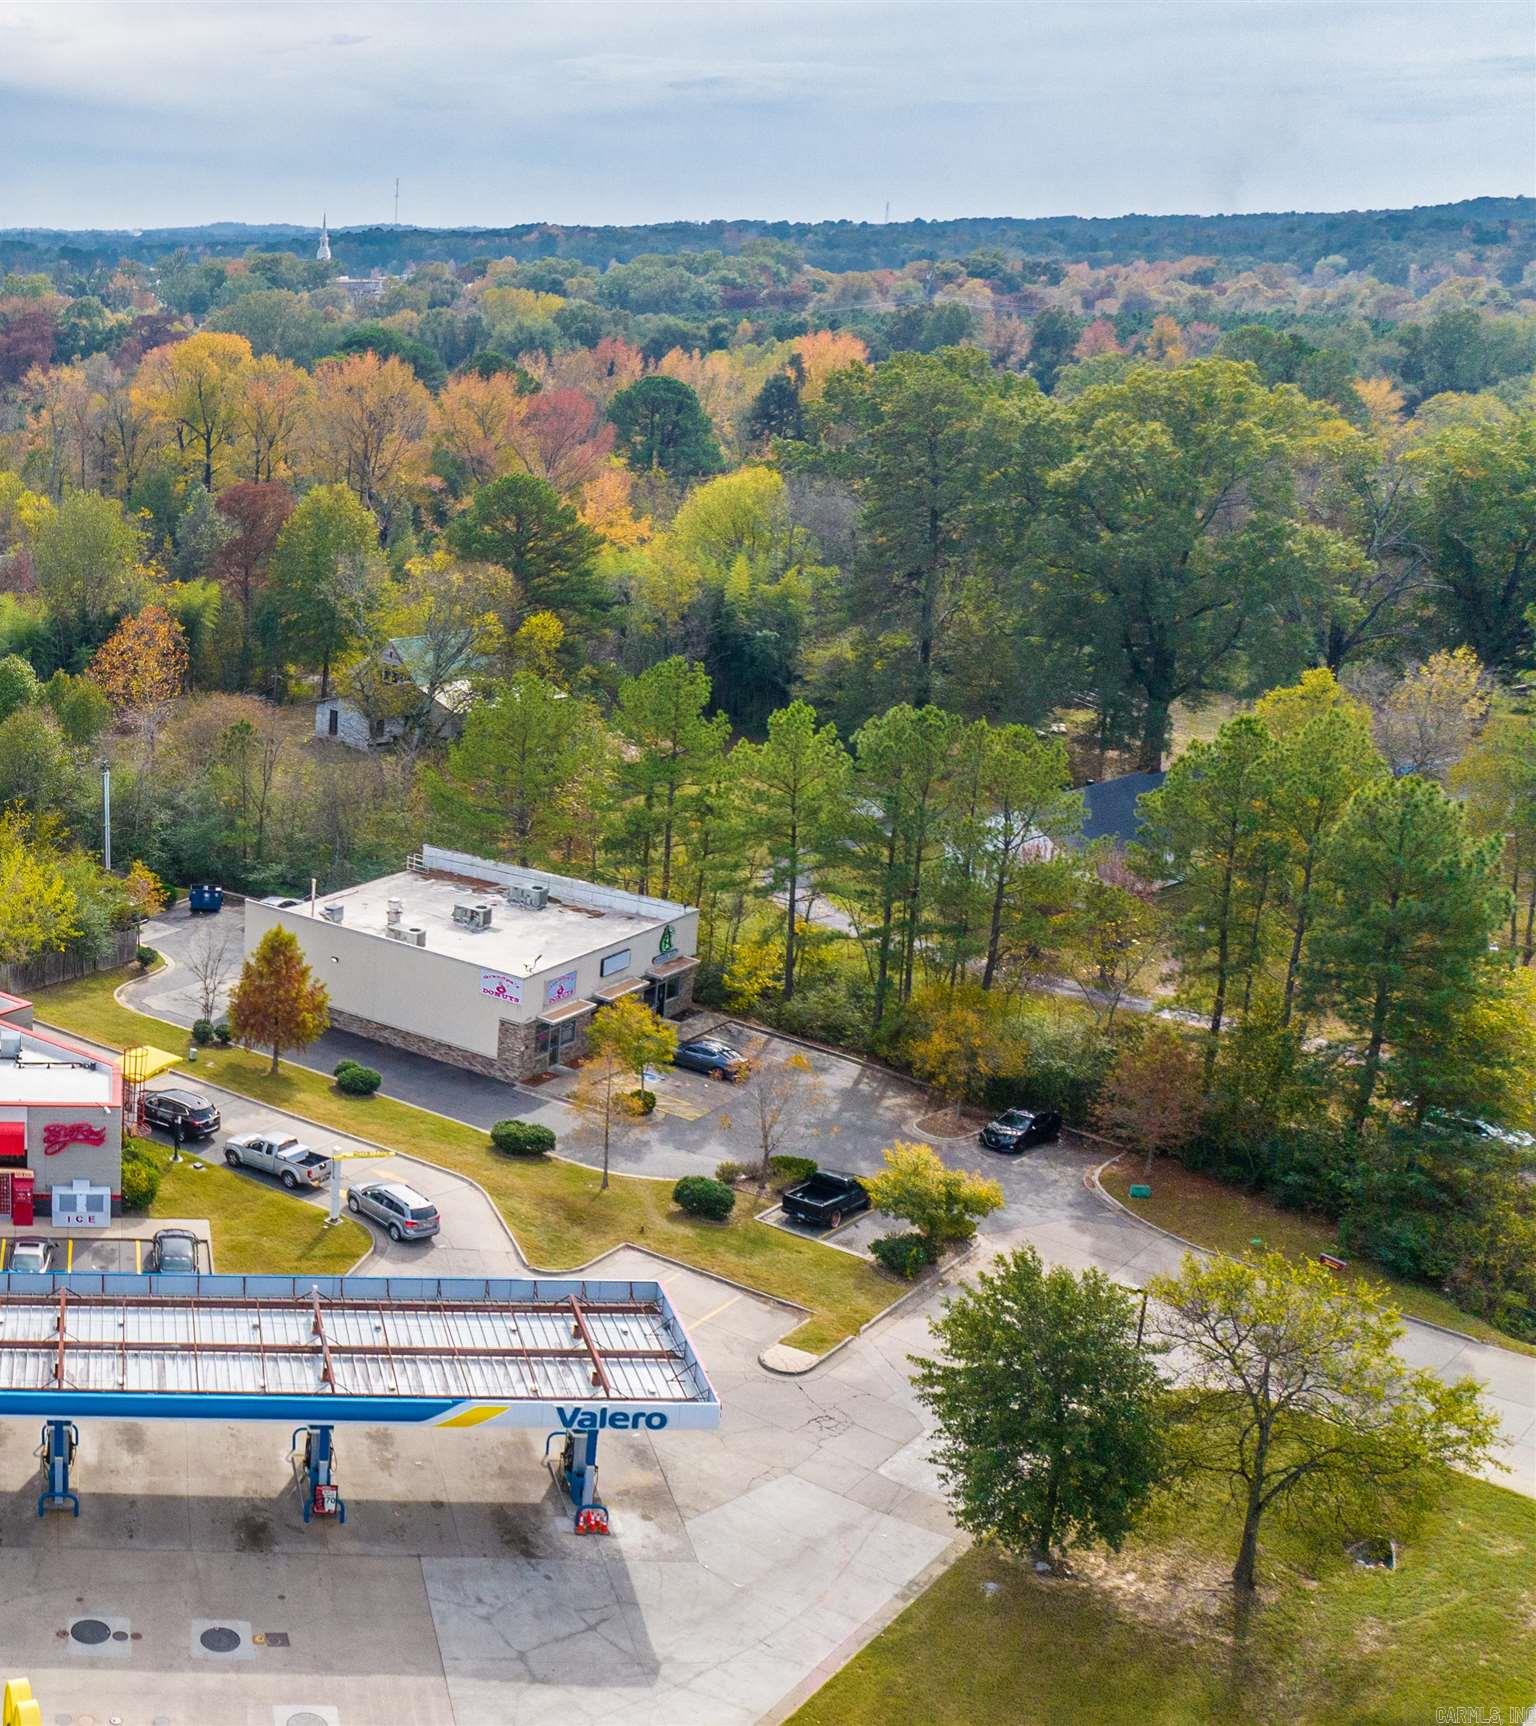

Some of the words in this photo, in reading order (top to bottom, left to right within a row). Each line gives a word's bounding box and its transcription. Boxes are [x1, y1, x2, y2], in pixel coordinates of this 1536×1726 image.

[482, 988, 520, 1003] DONUTS
[67, 1215, 96, 1223] ICE
[556, 1407, 668, 1430] Valero
